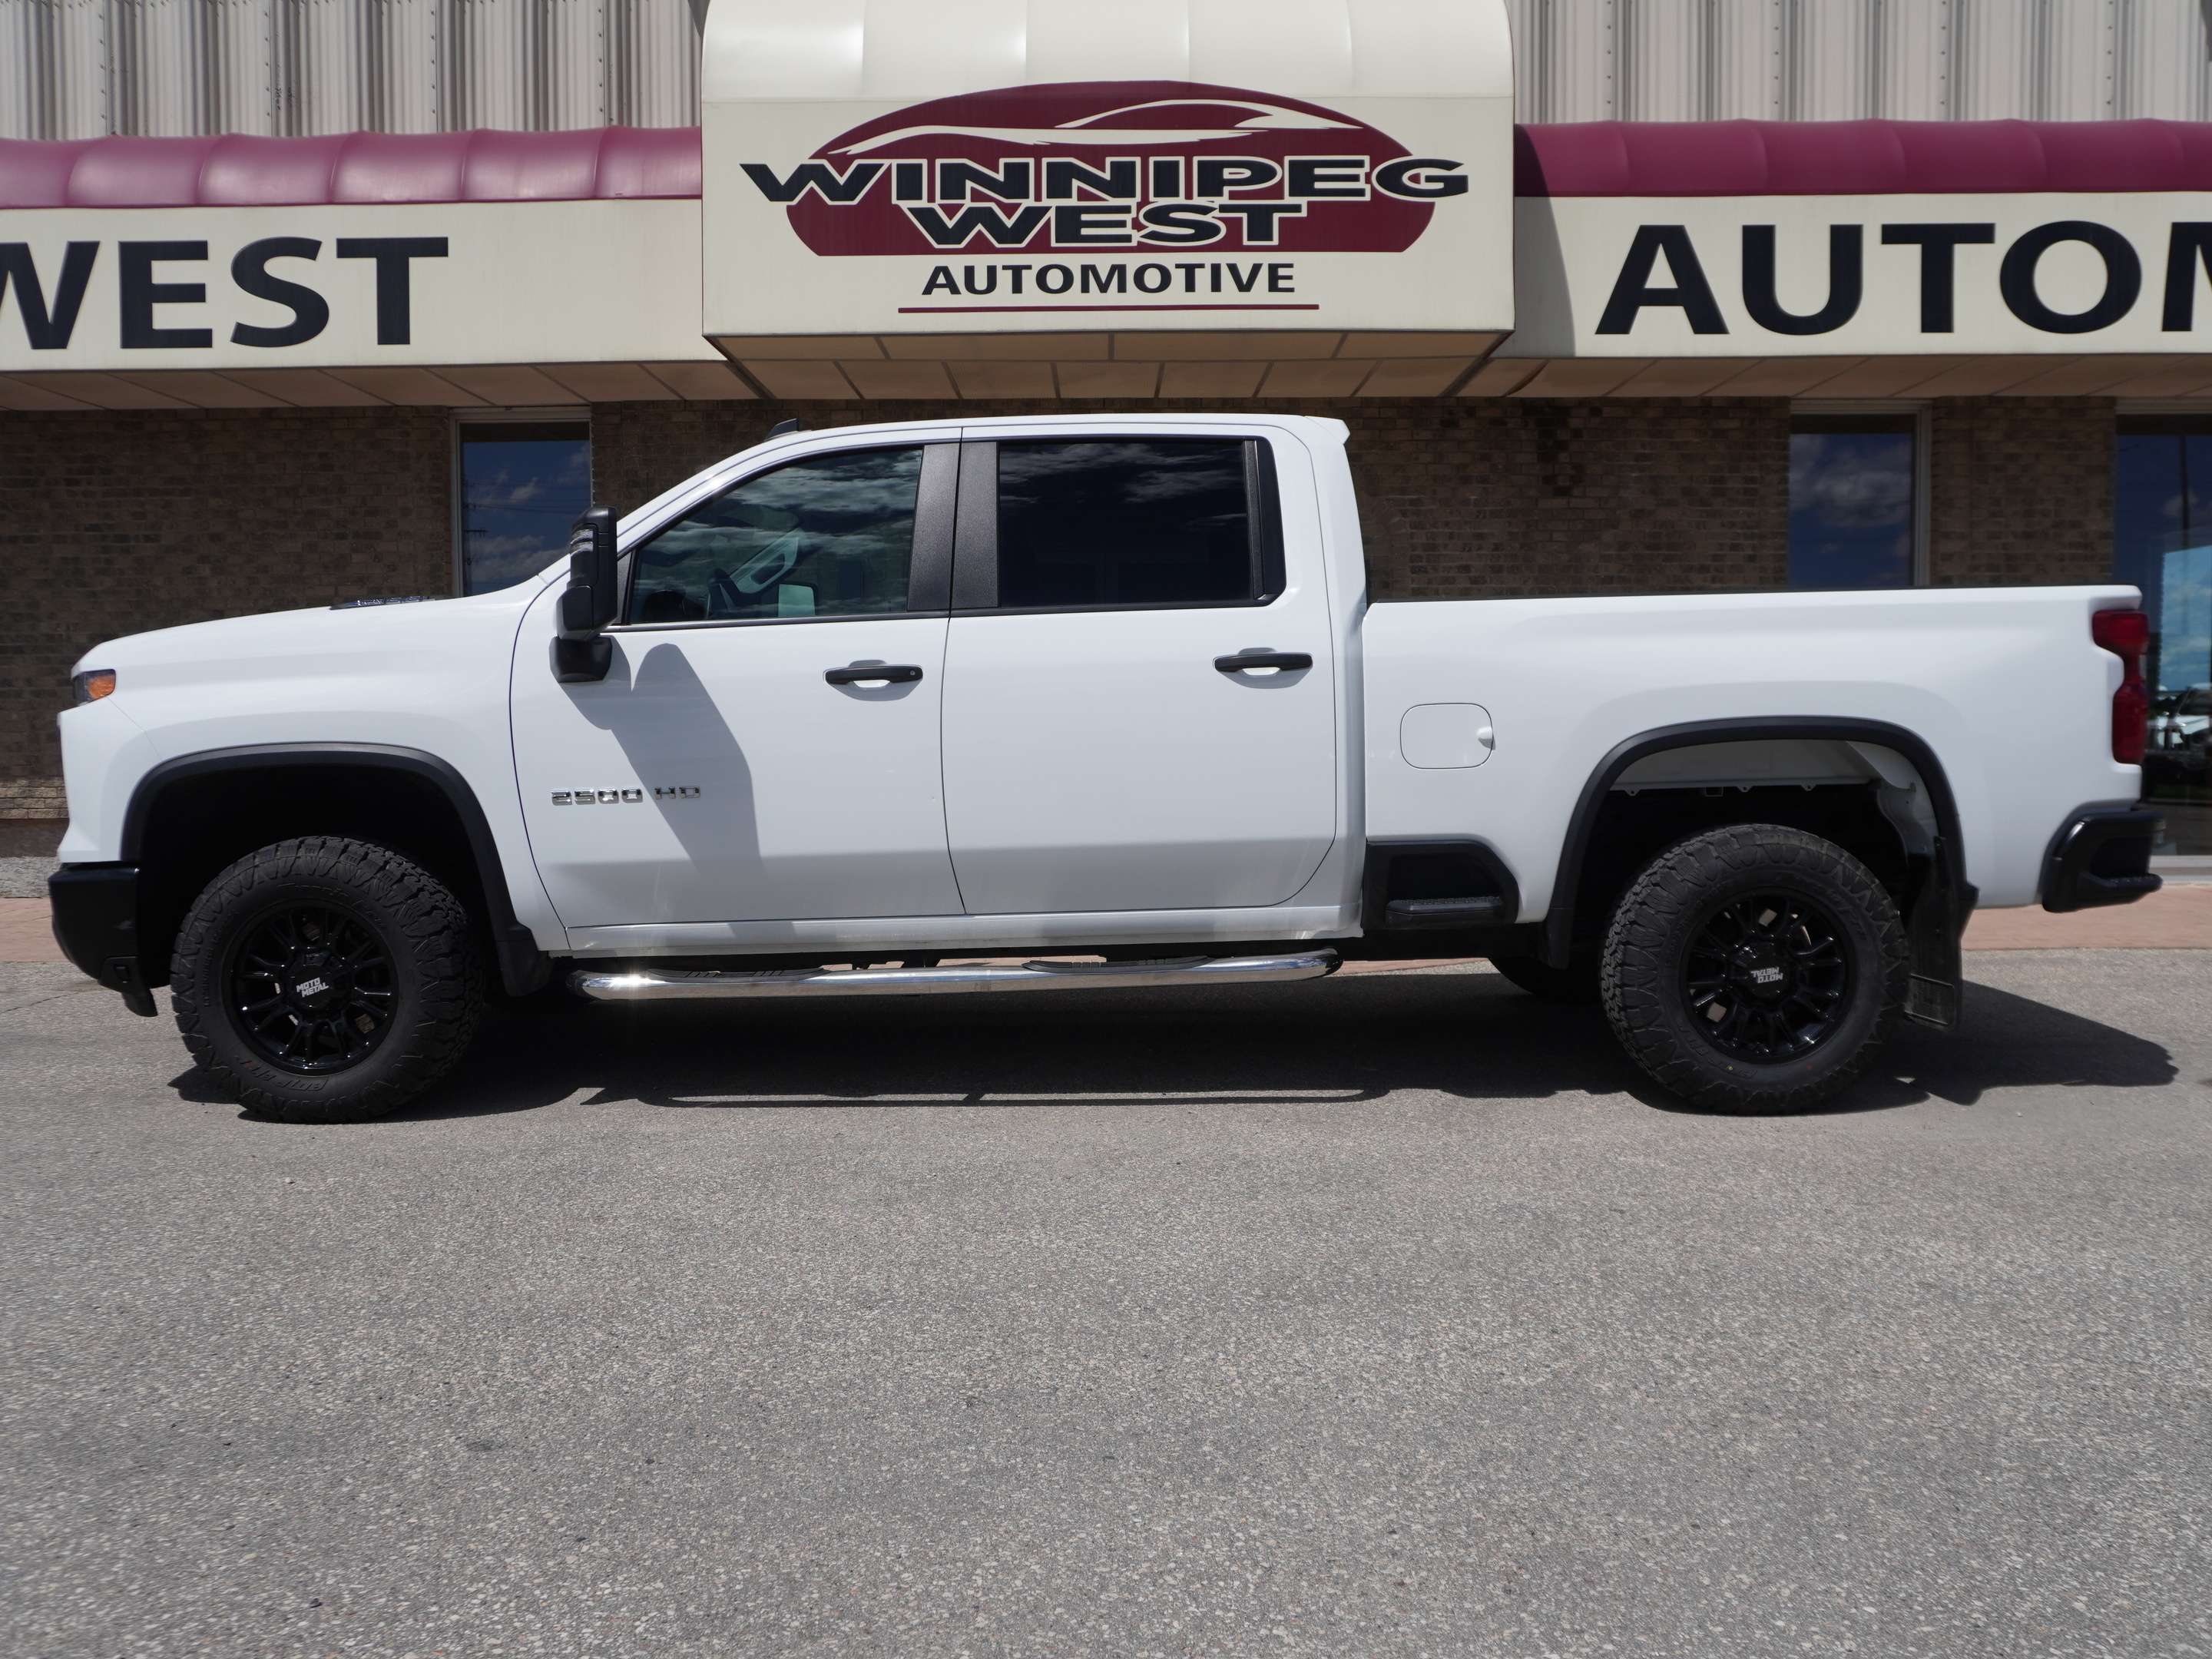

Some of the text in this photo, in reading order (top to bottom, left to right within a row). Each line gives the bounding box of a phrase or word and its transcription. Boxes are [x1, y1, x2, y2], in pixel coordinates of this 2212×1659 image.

[740, 157, 1469, 204] WINNIPEG
[906, 203, 1303, 247] WEST
[921, 263, 1295, 296] AUTOMOTIVE
[551, 786, 701, 805] 2500 HD
[1751, 967, 1780, 977] METAL
[1757, 973, 1783, 983] MOTO
[296, 977, 321, 992] MOTO
[302, 982, 329, 997] METAL
